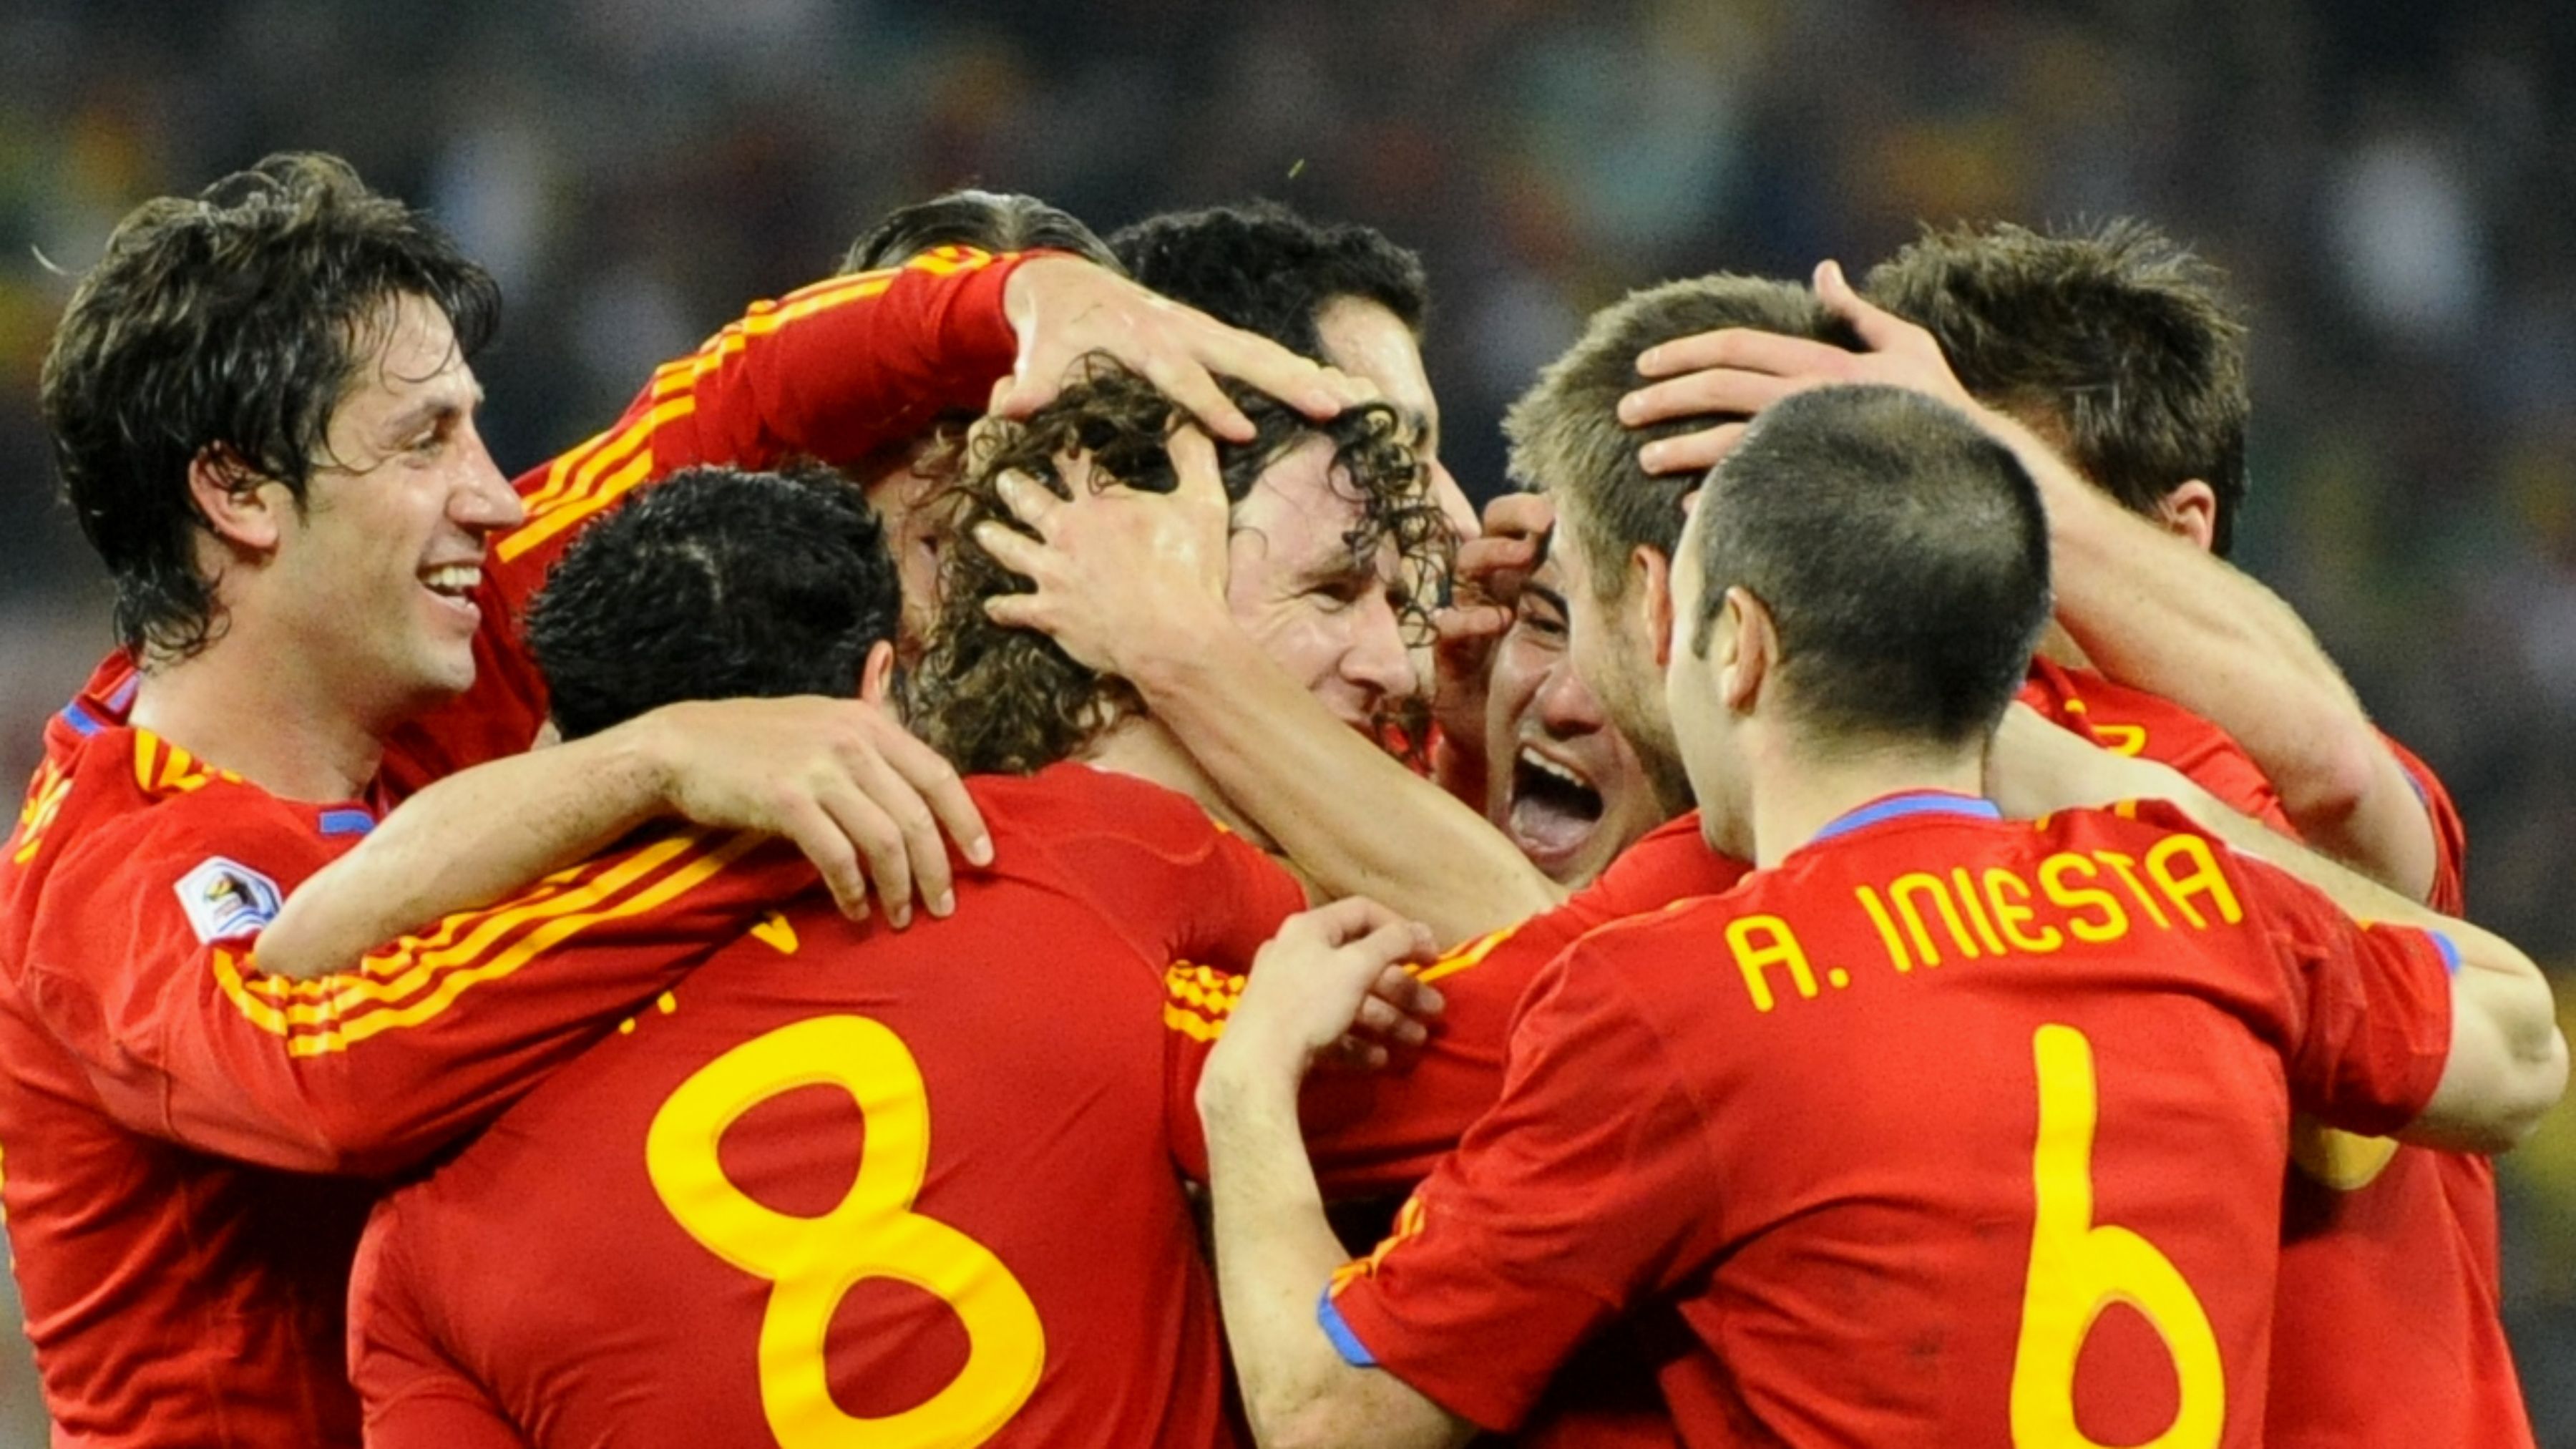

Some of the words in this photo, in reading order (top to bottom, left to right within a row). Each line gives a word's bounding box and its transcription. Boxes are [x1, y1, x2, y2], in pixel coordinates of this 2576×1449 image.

[1724, 914, 1850, 1013] A.
[1855, 833, 2244, 973] INIESTA
[645, 1013, 1046, 1449] 8
[2009, 1023, 2226, 1449] 6
